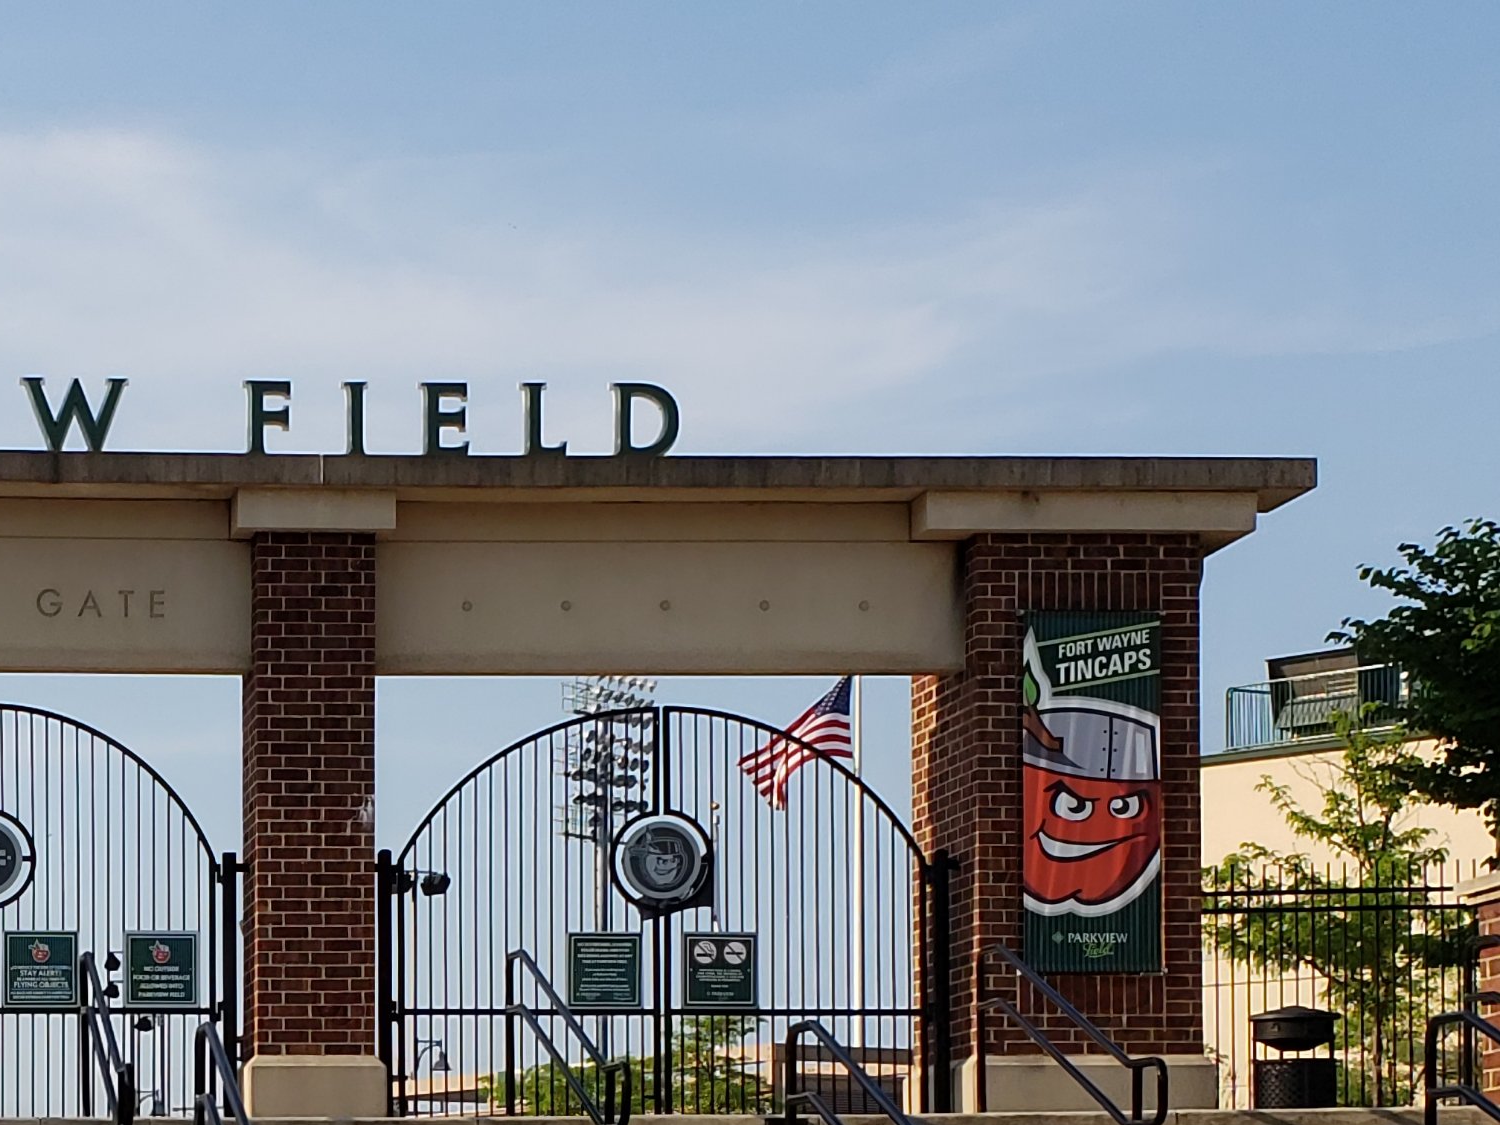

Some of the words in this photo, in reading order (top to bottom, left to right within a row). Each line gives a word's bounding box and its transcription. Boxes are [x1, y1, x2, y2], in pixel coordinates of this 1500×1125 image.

[242, 378, 681, 458] FIELD
[36, 589, 165, 619] GATE
[1058, 639, 1094, 659] FORT
[1097, 629, 1150, 651] WAYNE
[1055, 648, 1151, 684] TINCAPS
[1067, 932, 1128, 943] PARKVIEW
[1082, 942, 1114, 958] Field
